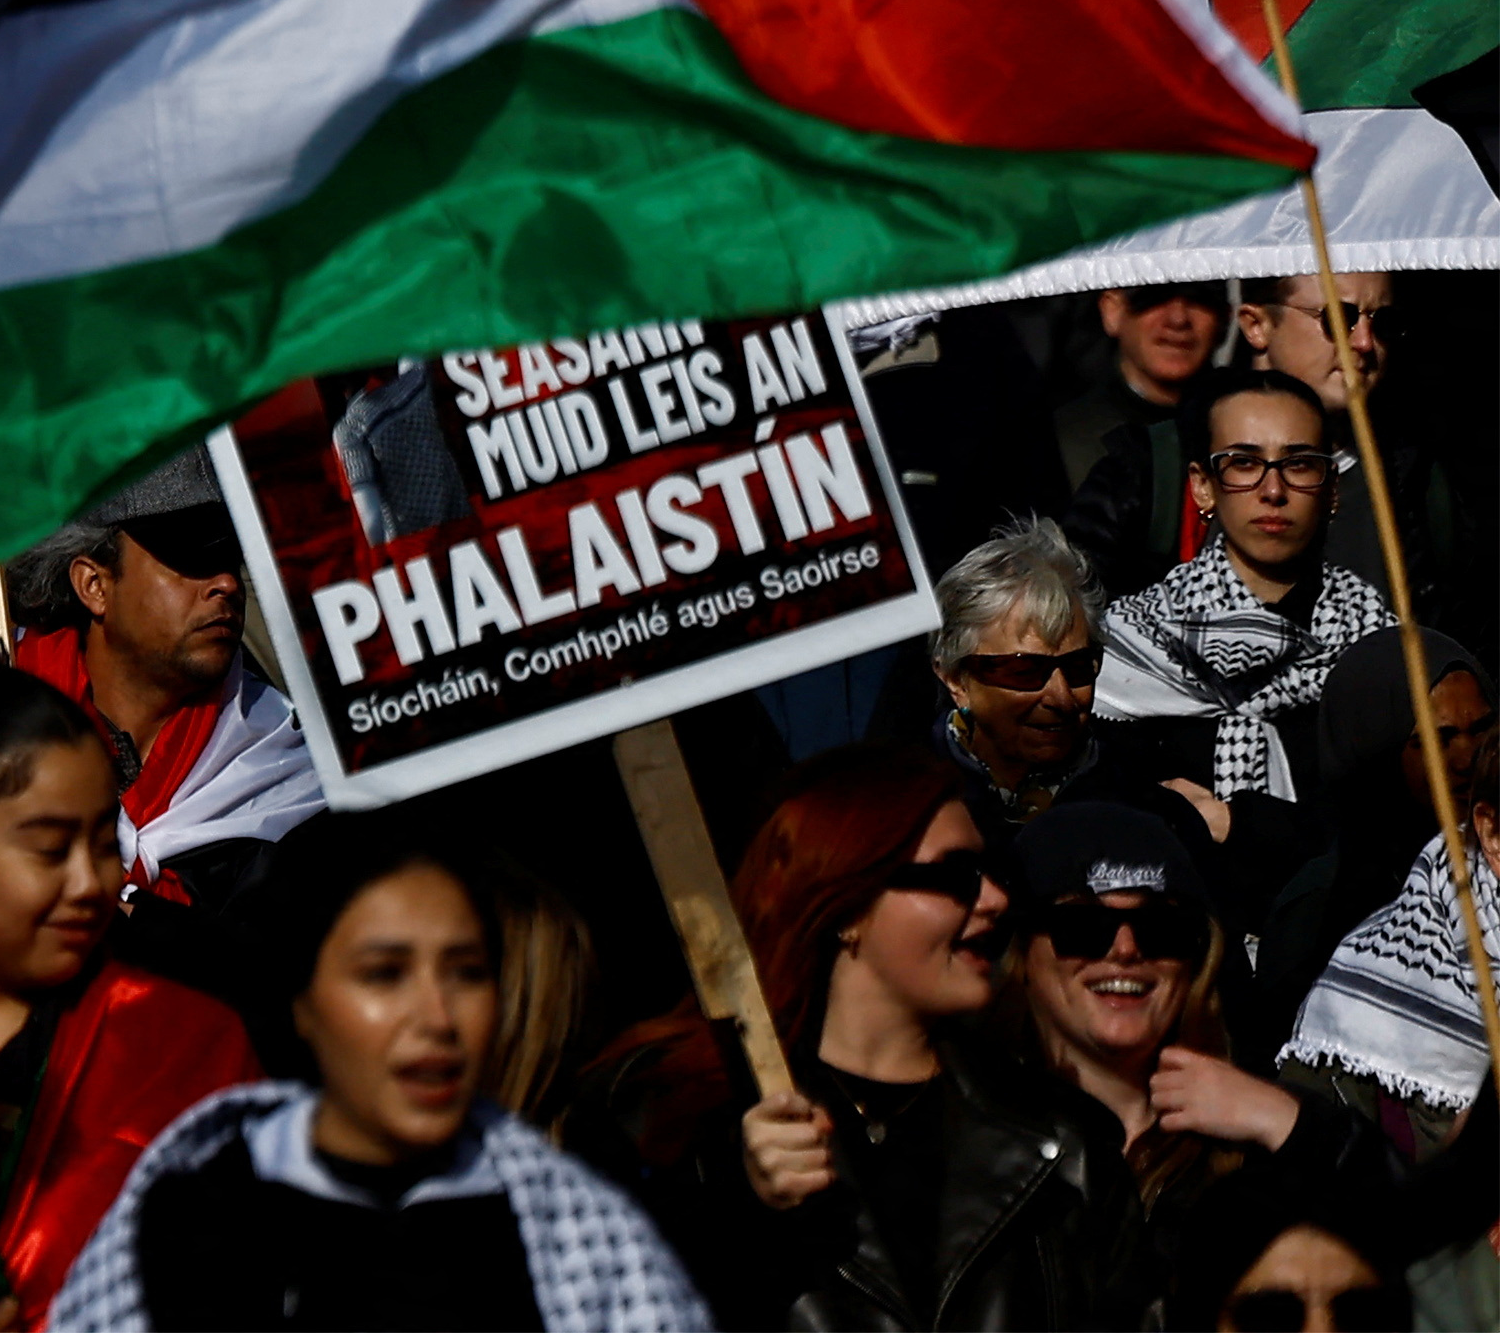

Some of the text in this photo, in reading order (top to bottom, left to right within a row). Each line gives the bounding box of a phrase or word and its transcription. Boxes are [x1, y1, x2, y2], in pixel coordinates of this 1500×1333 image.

[466, 317, 828, 501] MUID LEIS AN
[312, 415, 873, 686] PHALAISTÍN
[348, 539, 883, 734] Síocháin, Comhphlé agus Saoirse
